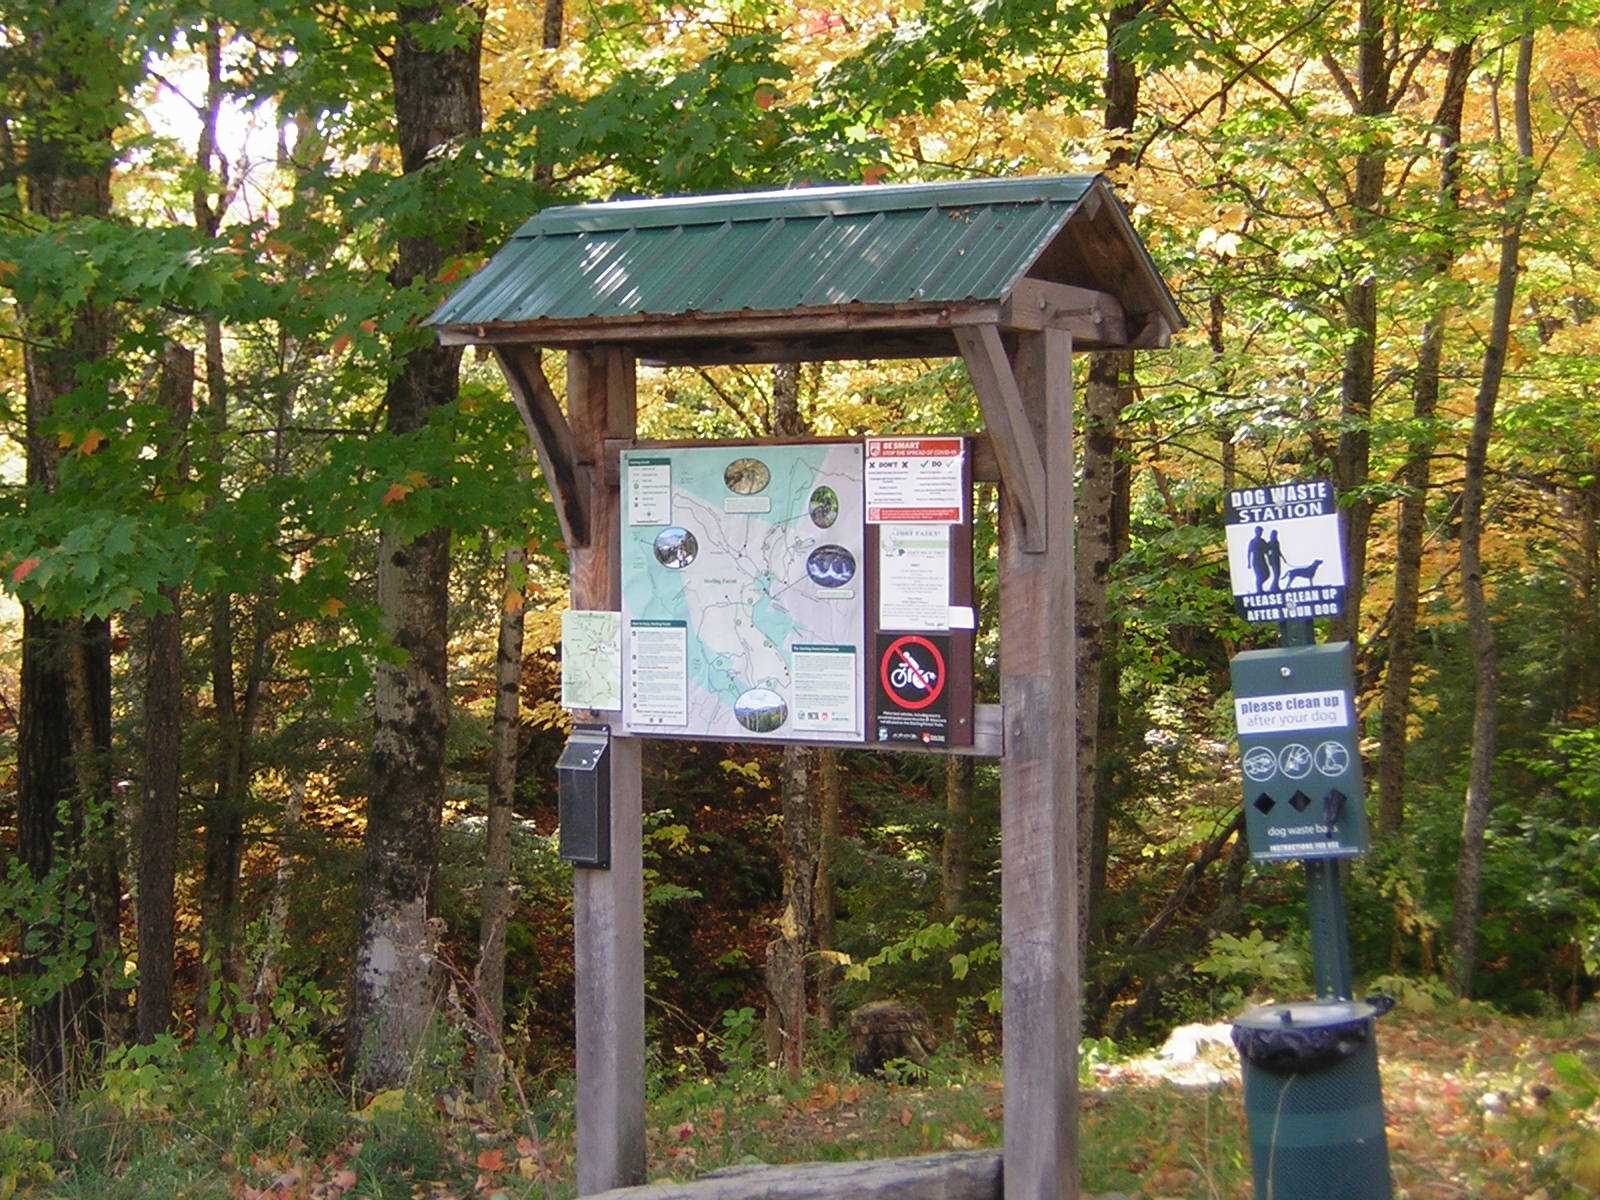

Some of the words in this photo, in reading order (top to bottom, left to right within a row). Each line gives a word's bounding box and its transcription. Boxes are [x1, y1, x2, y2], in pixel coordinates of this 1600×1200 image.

[1231, 490, 1266, 507] DOG
[1270, 482, 1327, 503] WASTE
[1238, 502, 1322, 523] STATION
[1242, 594, 1282, 607] PLEASE
[1285, 590, 1320, 603] CLEAN
[1322, 588, 1338, 600] UP
[1247, 608, 1280, 621] AFTER
[1282, 605, 1312, 618] YOUR
[1314, 603, 1338, 615] DOG
[1241, 700, 1283, 715] please
[1286, 697, 1320, 710] clean
[1324, 696, 1339, 708] up
[1247, 715, 1275, 727] after
[1280, 713, 1308, 727] your
[1311, 710, 1337, 723] dog
[1268, 826, 1286, 837] dog
[1287, 825, 1314, 835] waste
[1315, 824, 1338, 834] bas
